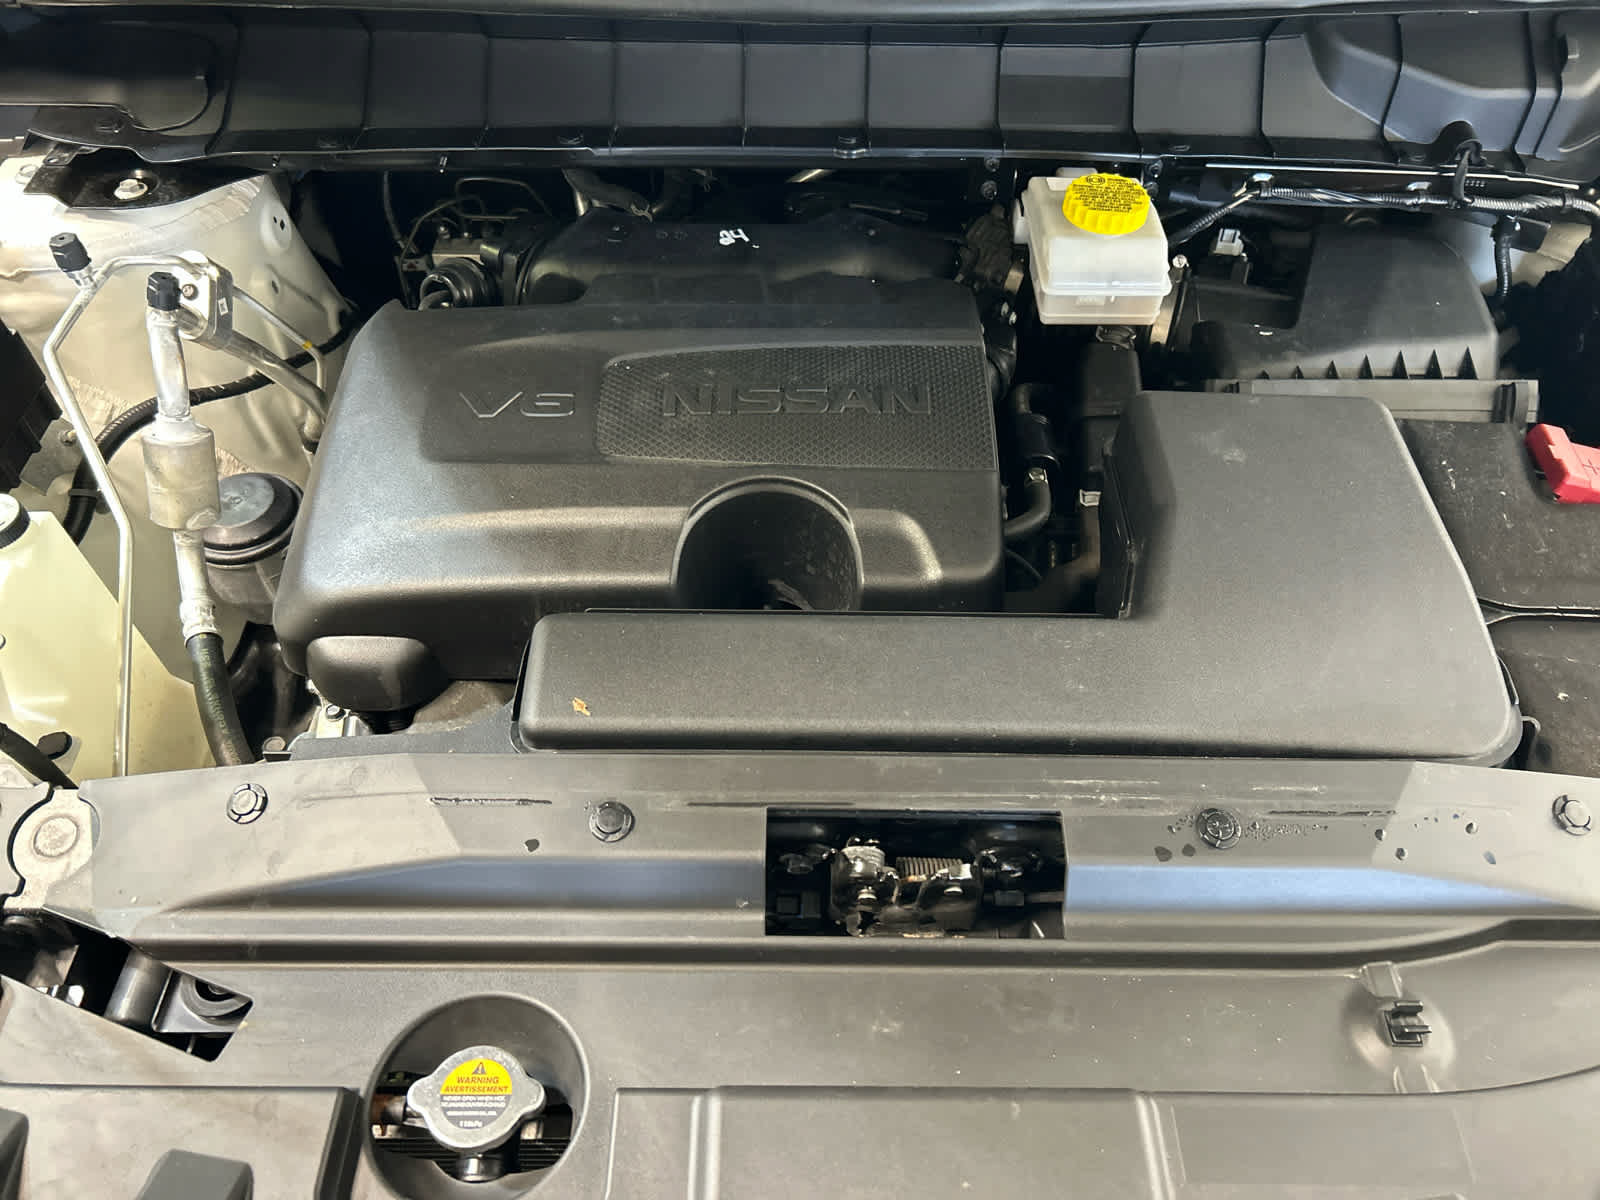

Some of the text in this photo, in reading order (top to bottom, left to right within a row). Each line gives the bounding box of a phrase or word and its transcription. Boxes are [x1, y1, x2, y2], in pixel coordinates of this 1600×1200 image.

[459, 390, 575, 418] V6
[662, 383, 933, 417] NISSAN
[443, 1085, 509, 1094] AVERTISSEMENT
[456, 1076, 500, 1085] WARNING
